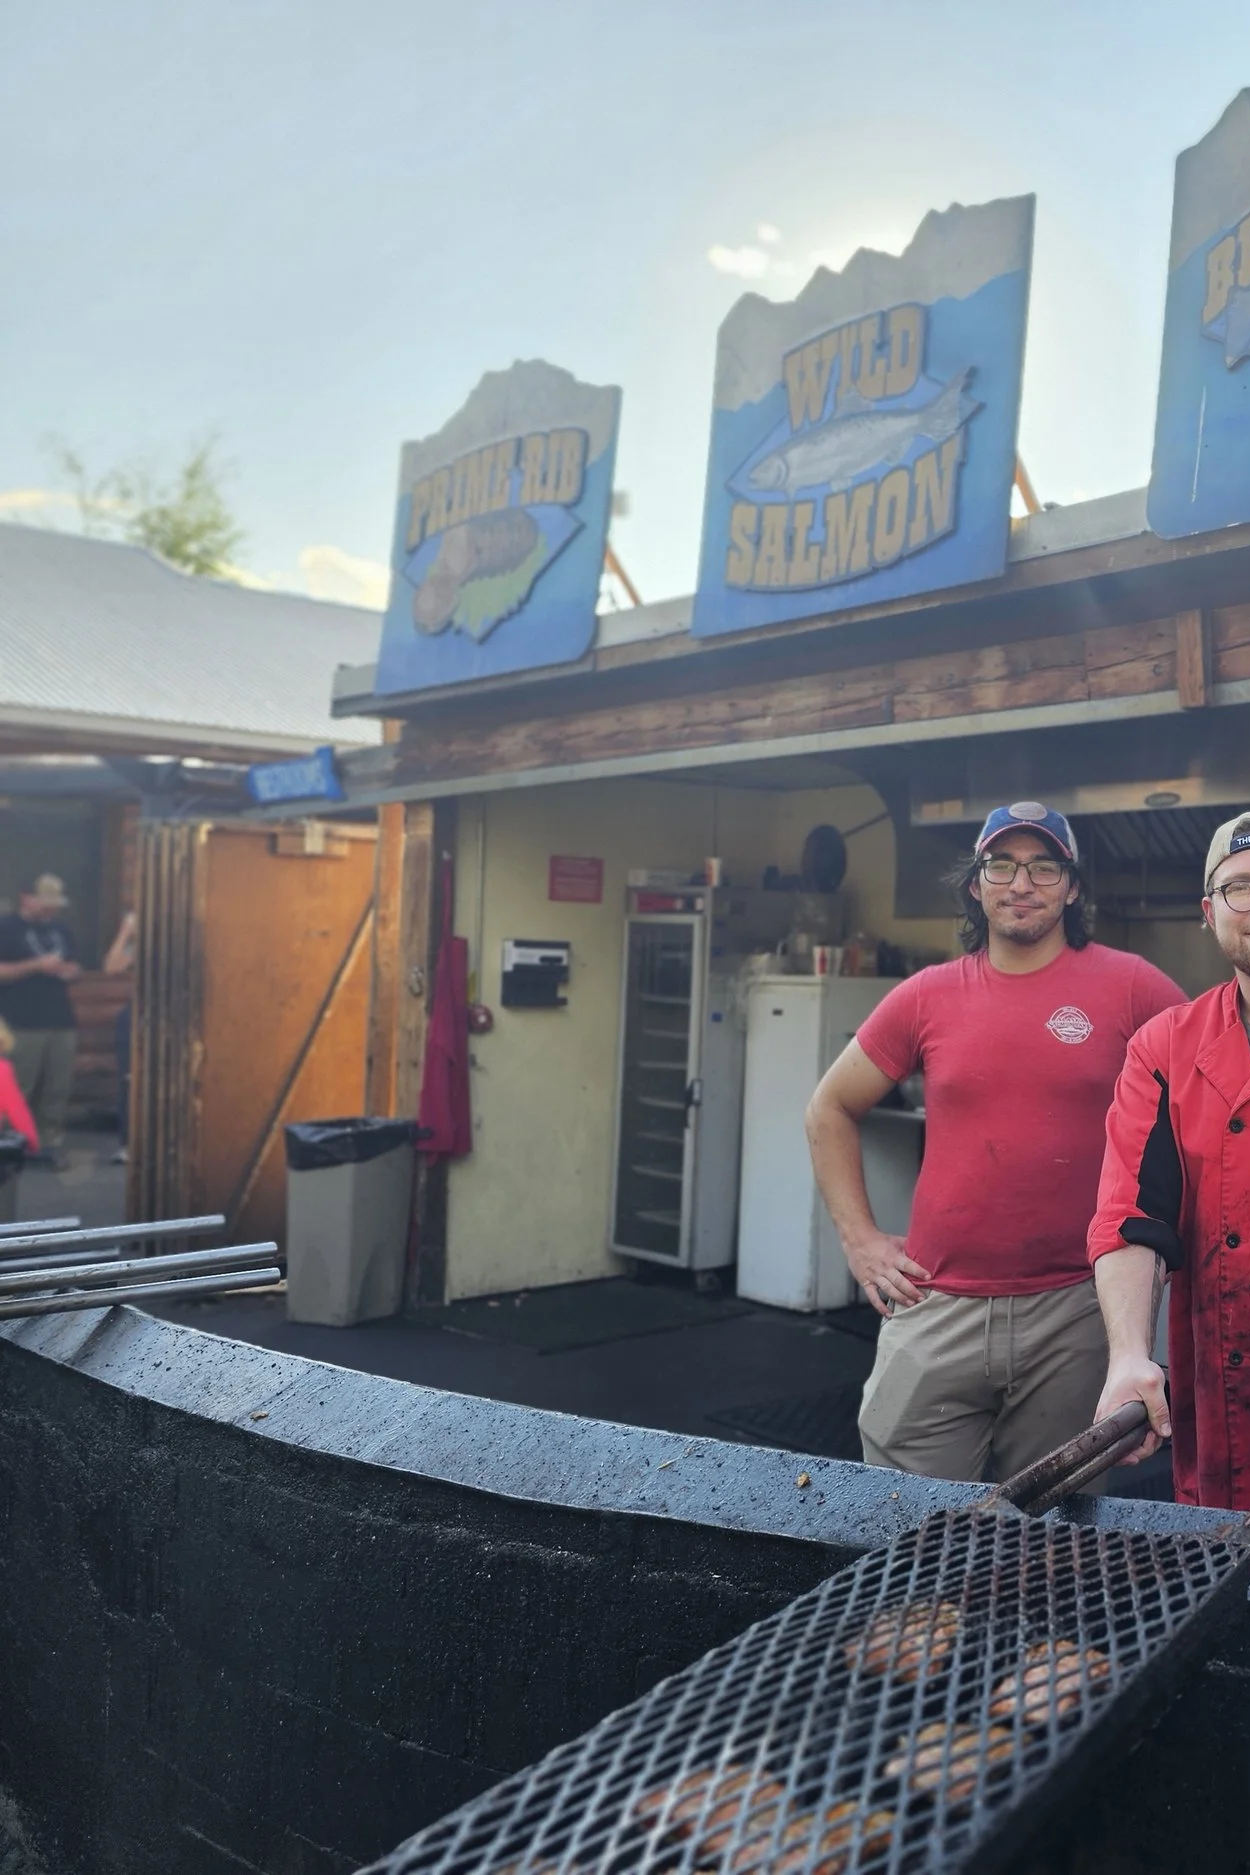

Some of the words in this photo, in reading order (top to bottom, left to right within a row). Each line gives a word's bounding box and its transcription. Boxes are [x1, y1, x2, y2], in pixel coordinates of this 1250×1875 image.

[784, 304, 922, 434] WILD
[406, 436, 516, 550] PRIME
[522, 430, 584, 504] RIB
[726, 434, 962, 588] SALMON
